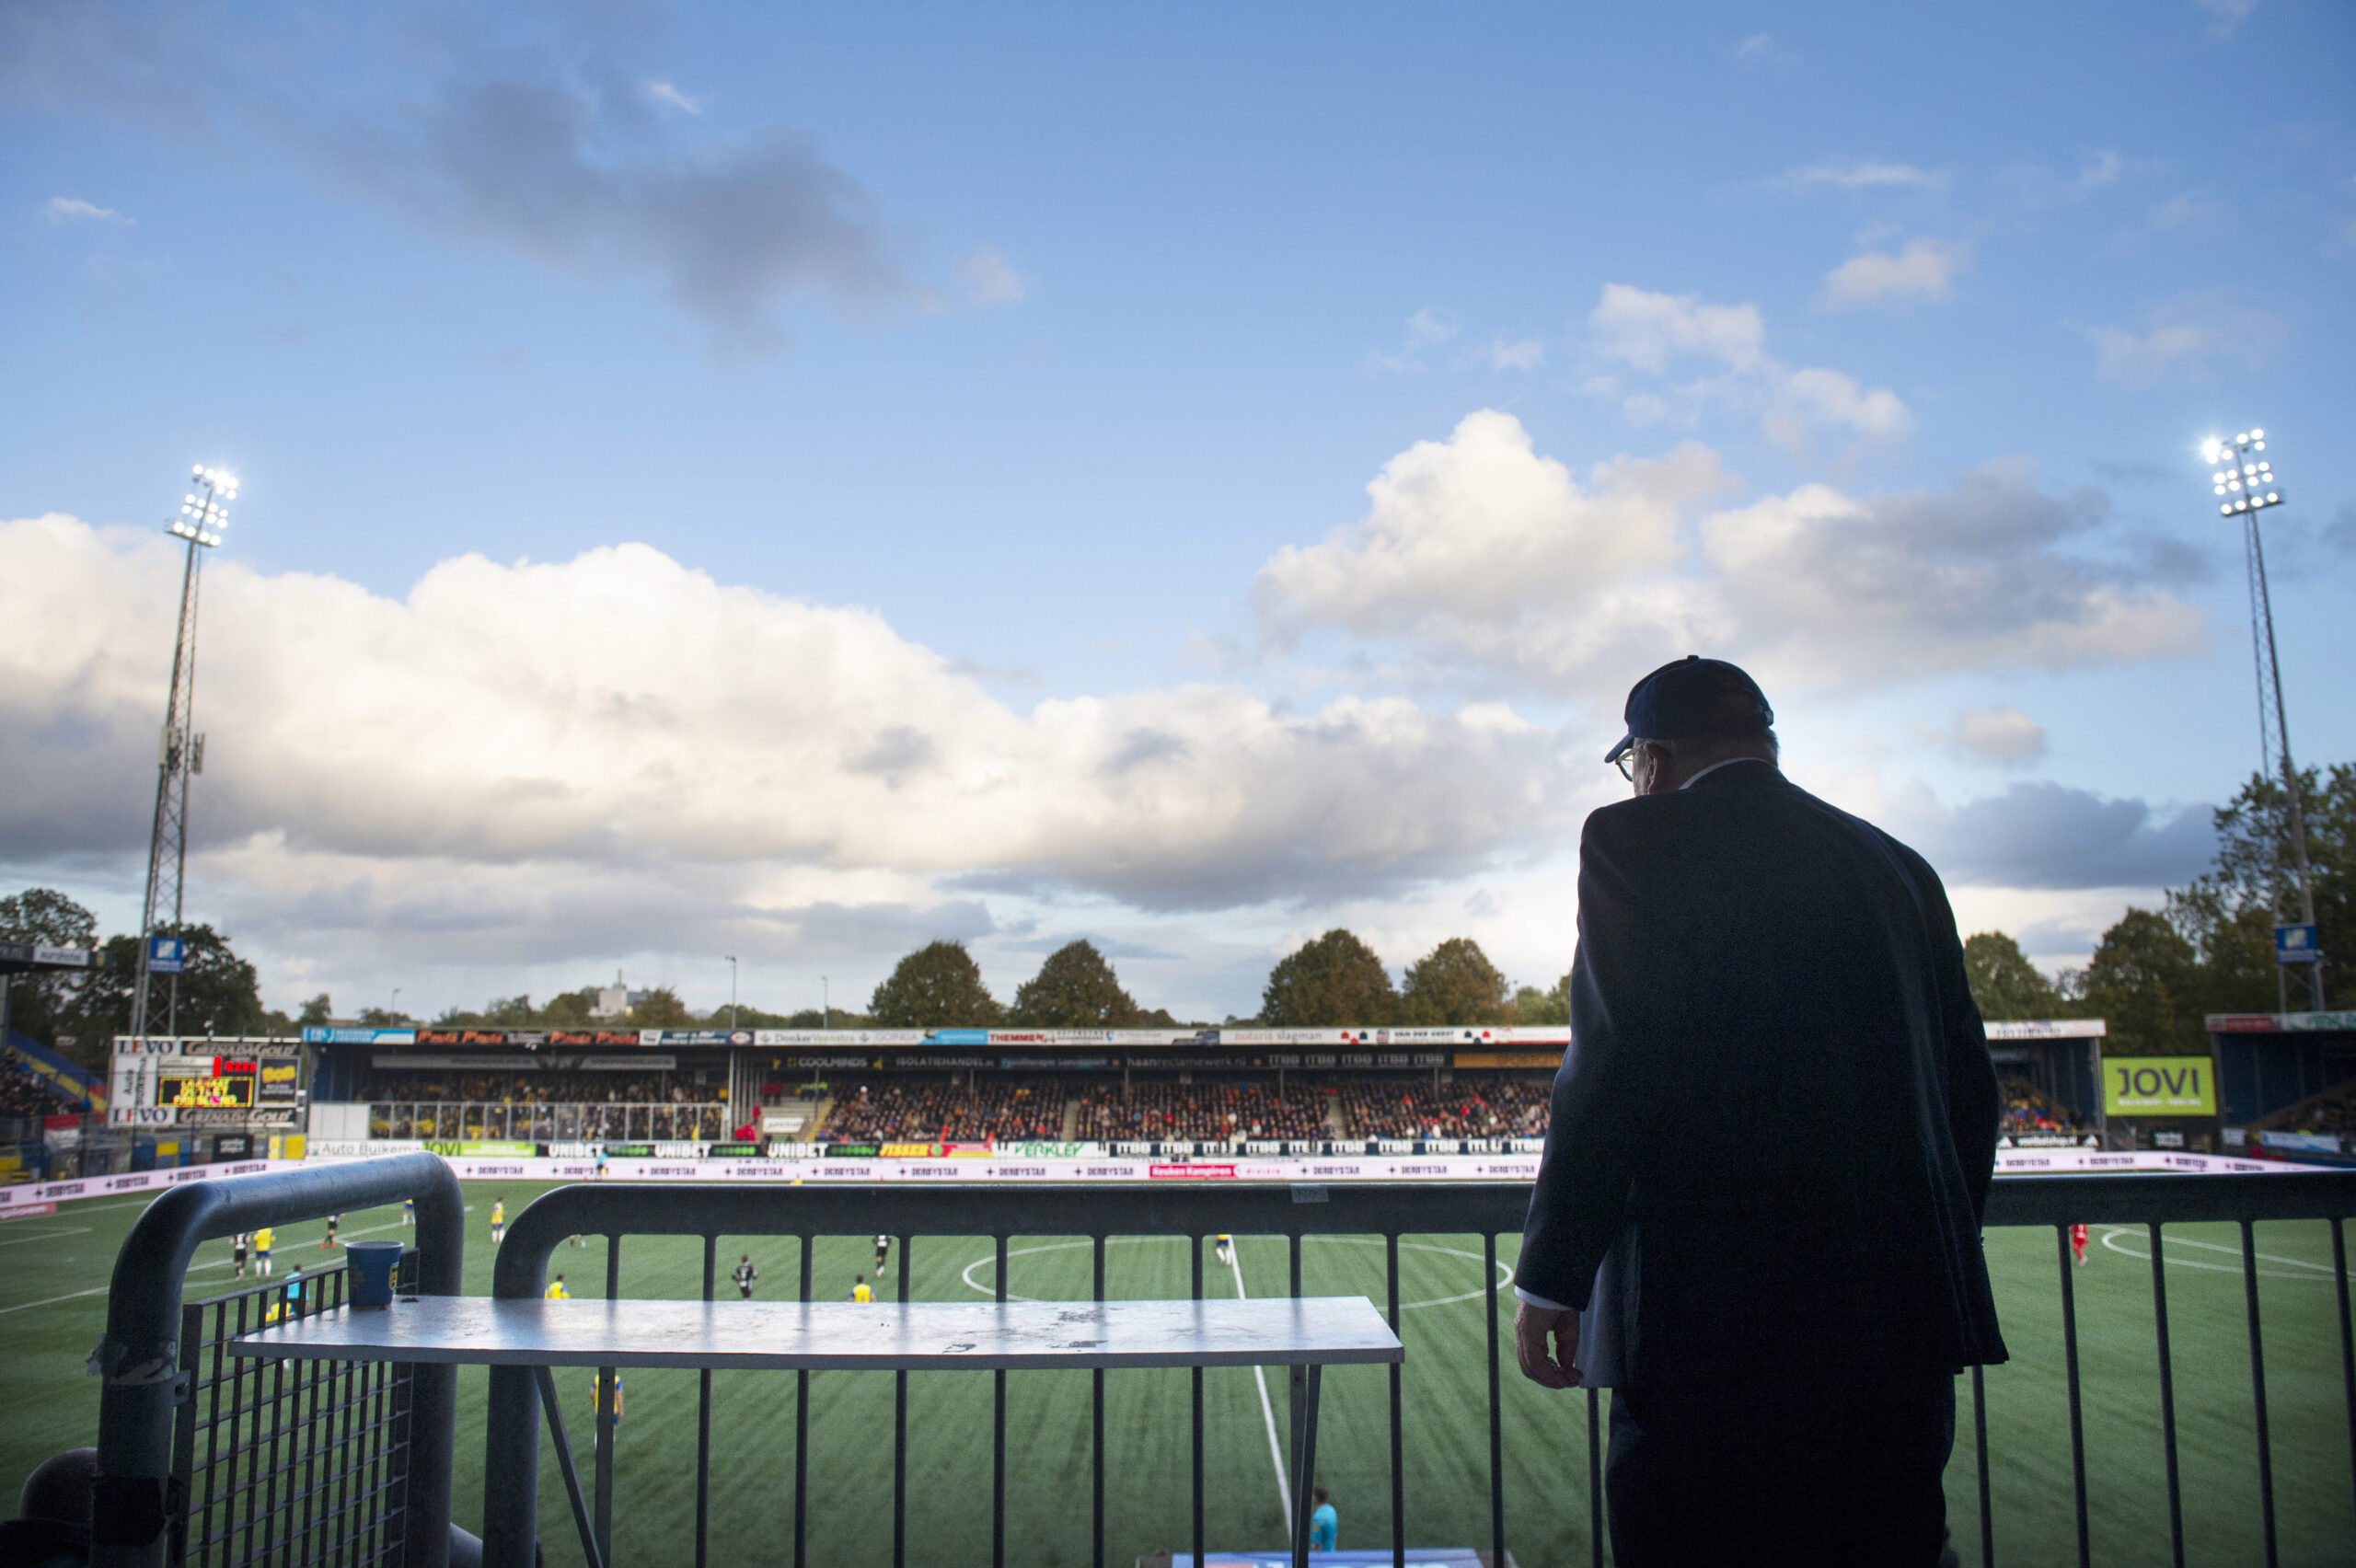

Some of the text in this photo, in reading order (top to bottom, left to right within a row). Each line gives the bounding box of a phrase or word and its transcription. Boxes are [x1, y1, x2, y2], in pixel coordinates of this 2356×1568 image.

[2118, 1067, 2200, 1096] JOVI
[321, 1143, 354, 1156] Auto
[654, 1143, 712, 1158] UNIBET
[767, 1143, 829, 1158] UNIBET
[1014, 1143, 1086, 1158] VERKLEY
[651, 1168, 697, 1176] DERBYSTAR
[737, 1168, 783, 1176] DERBYSTAR
[825, 1168, 871, 1176] DERBYSTAR
[911, 1168, 958, 1176] DERBYSTAR
[999, 1167, 1046, 1176] DERBYSTAR
[1088, 1167, 1135, 1176] DERBYSTAR
[1313, 1166, 1360, 1175] DERBYSTAR
[1401, 1165, 1448, 1174] DERBYSTAR
